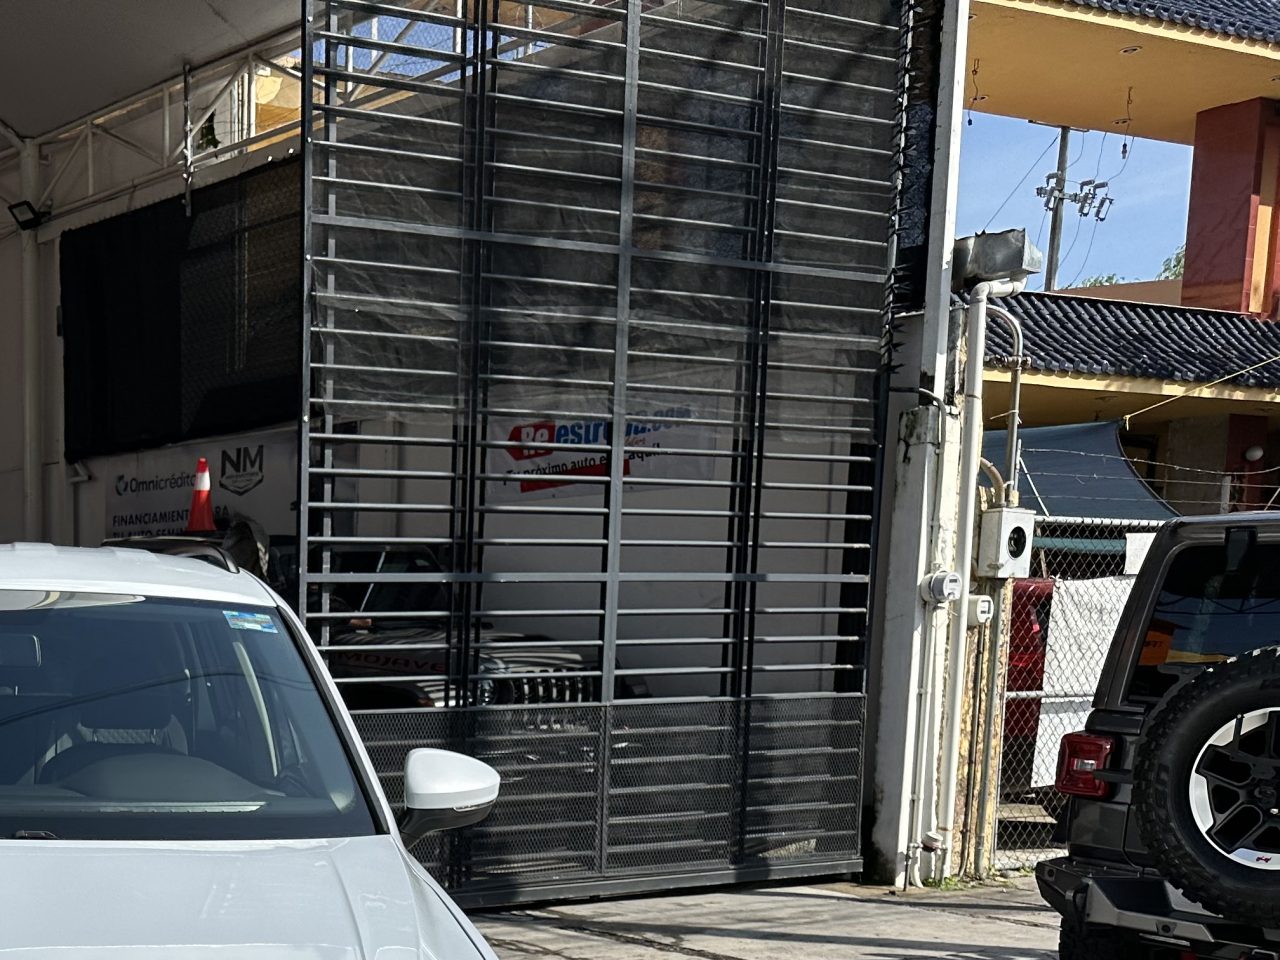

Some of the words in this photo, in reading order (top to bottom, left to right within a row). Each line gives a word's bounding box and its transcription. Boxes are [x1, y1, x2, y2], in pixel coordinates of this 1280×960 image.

[222, 445, 264, 478] NM
[112, 509, 189, 528] FINANCIAMIENT
[337, 651, 446, 674] MOJAVE
